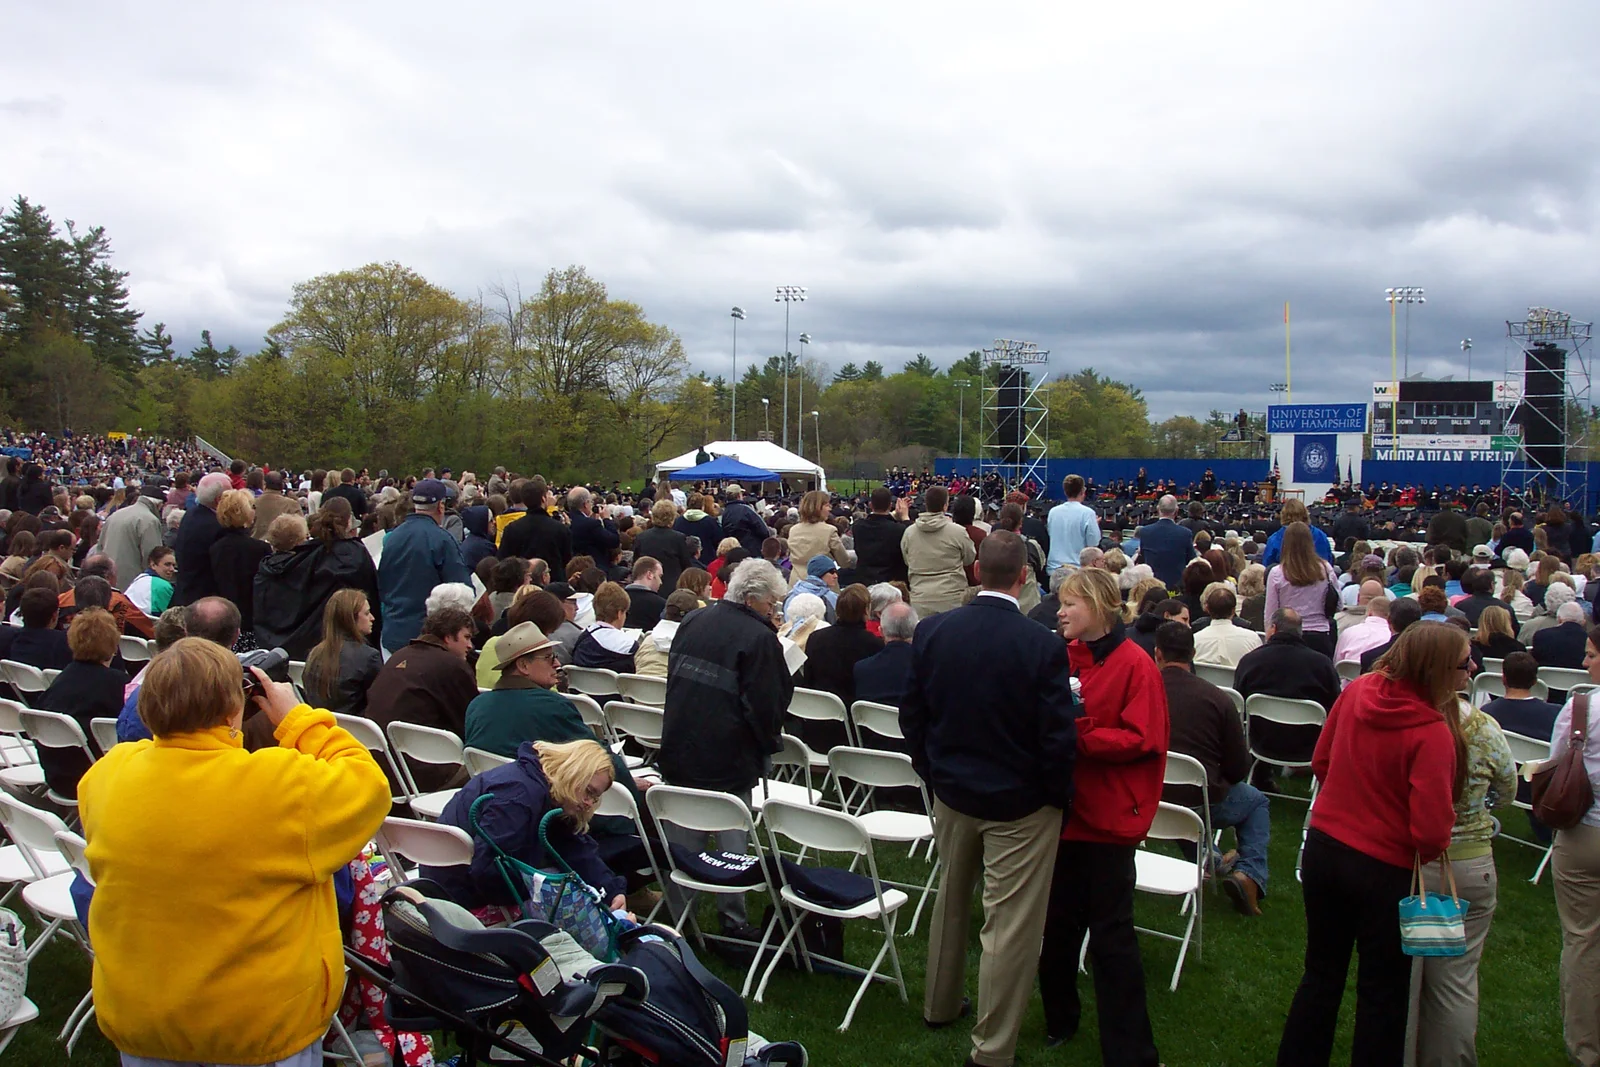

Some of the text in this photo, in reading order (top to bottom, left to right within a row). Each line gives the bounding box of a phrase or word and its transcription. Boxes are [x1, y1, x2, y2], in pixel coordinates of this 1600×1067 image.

[1271, 408, 1362, 419] UNIVERSITY OF
[1271, 418, 1361, 429] NEW HAMPSHIRE
[698, 852, 726, 867] NEW
